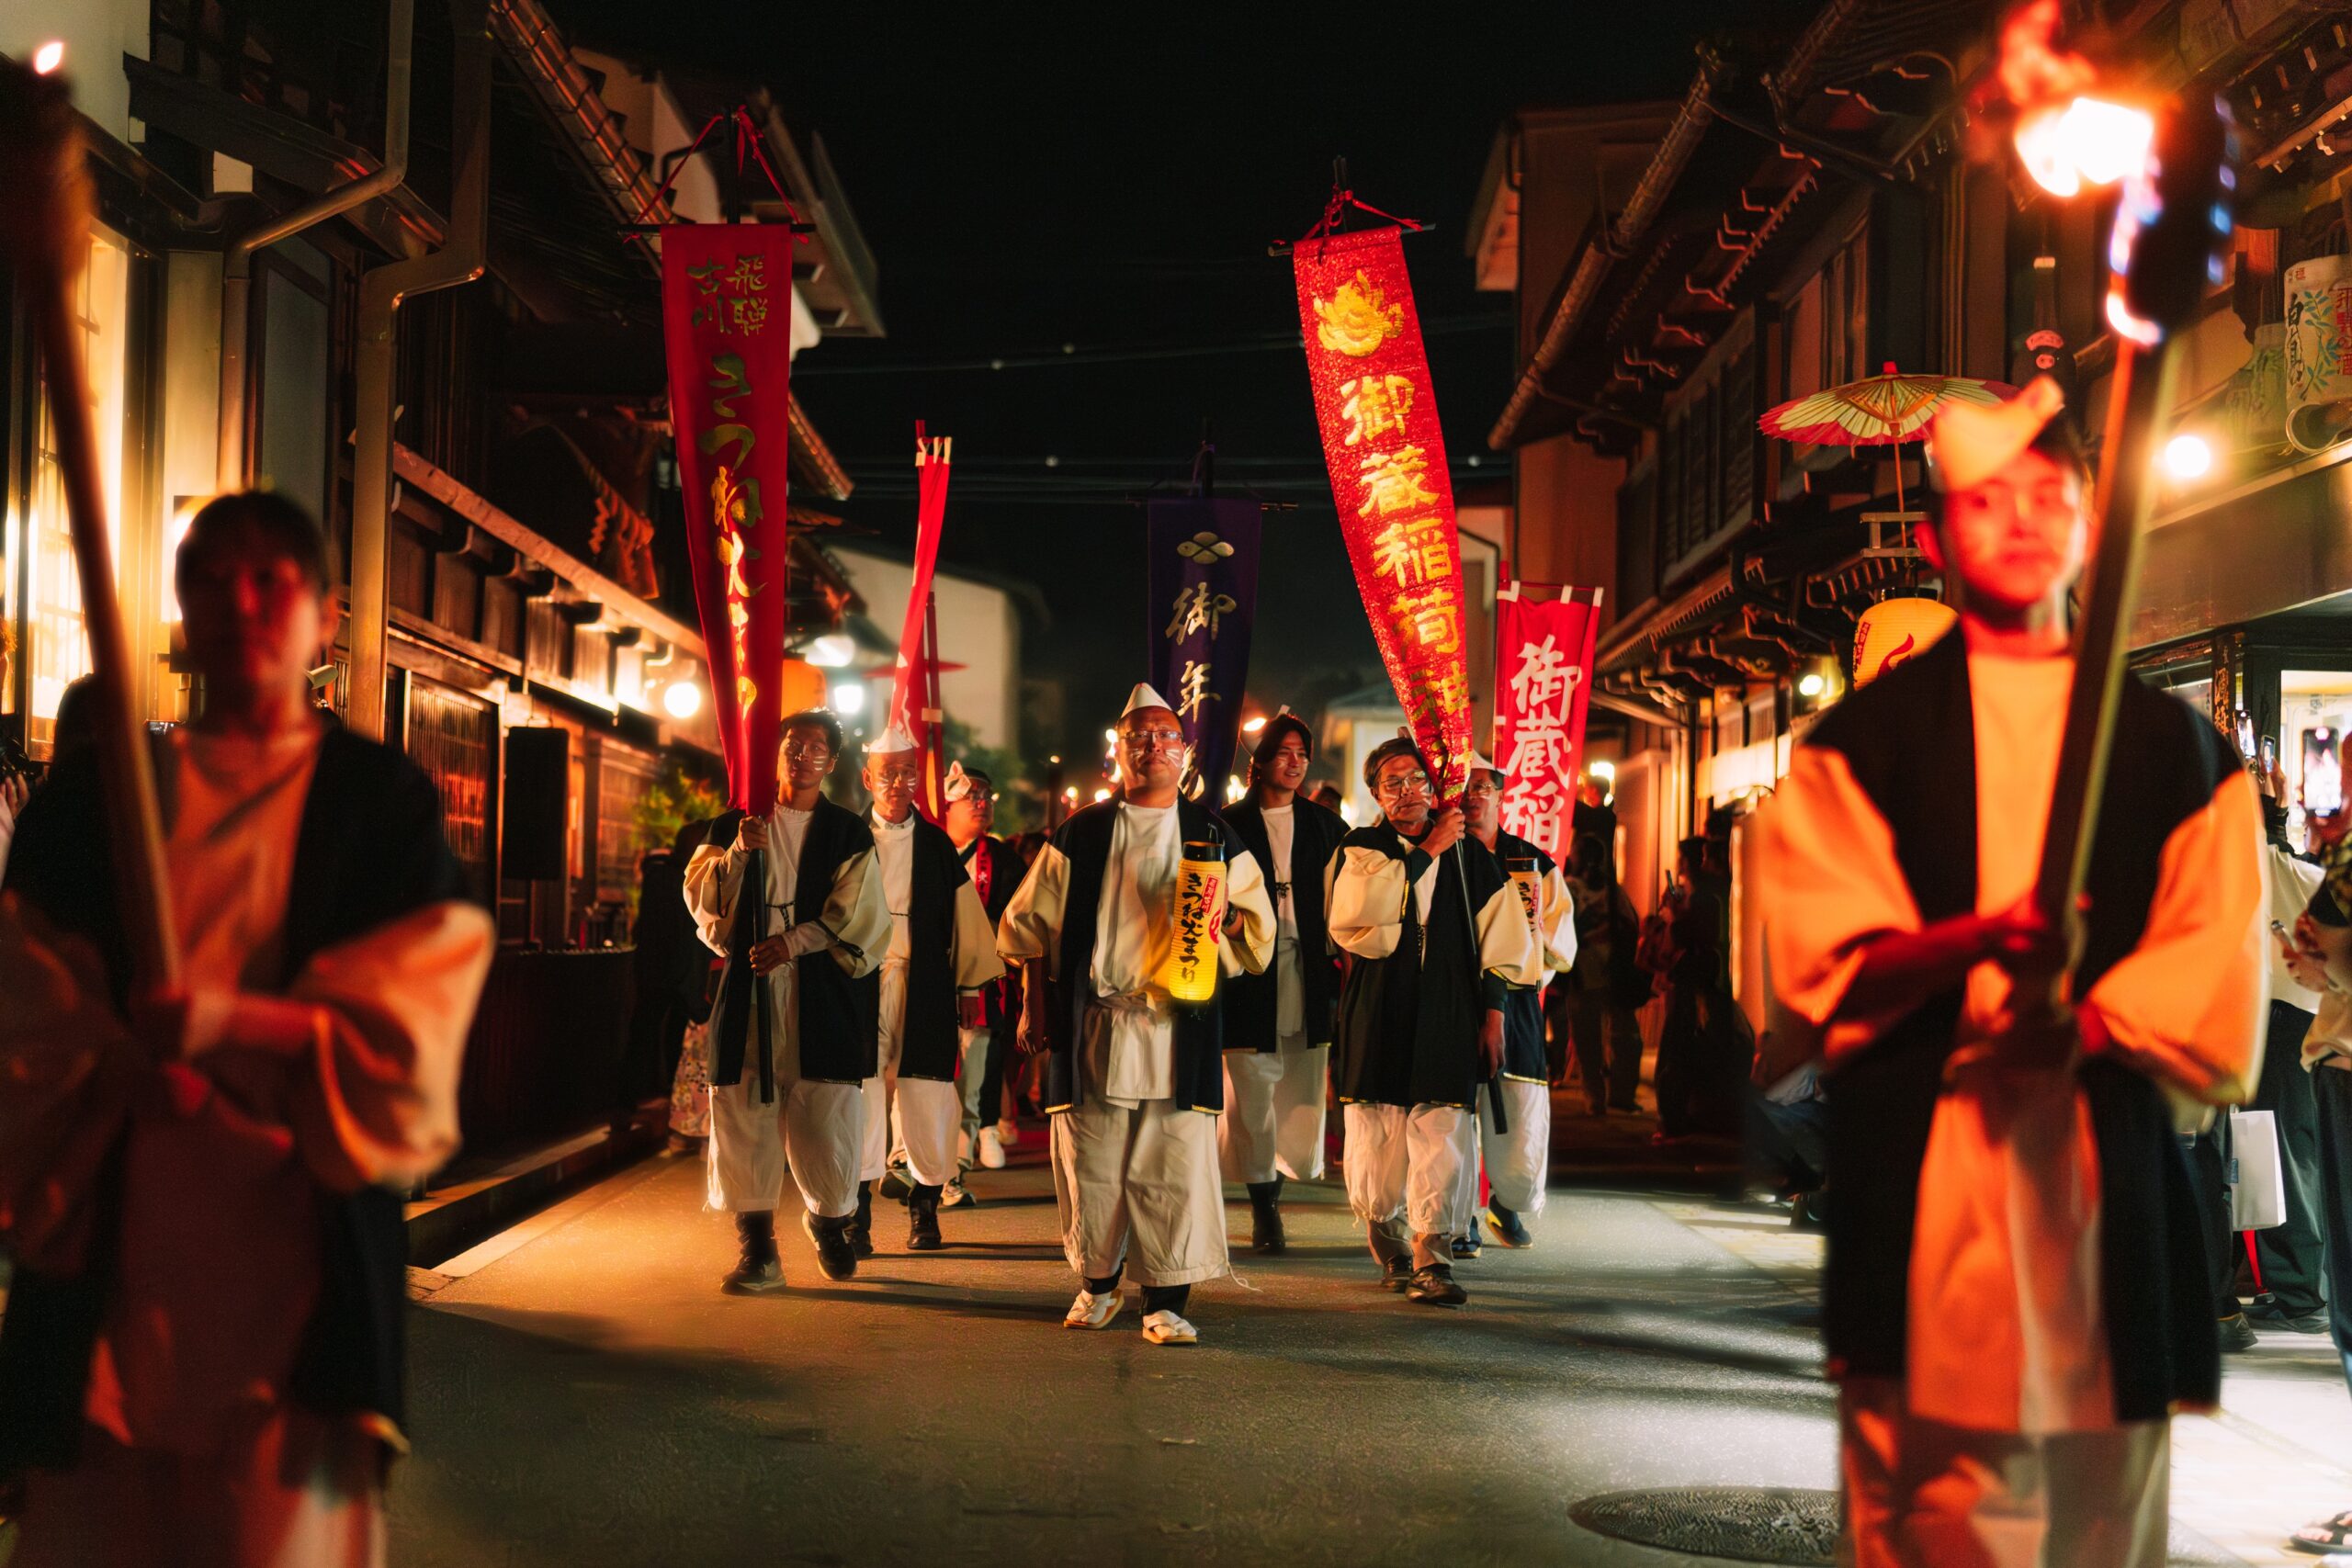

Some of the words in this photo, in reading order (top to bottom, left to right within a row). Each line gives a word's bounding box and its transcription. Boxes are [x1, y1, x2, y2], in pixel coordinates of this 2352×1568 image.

[1179, 872, 1204, 985] きつね火まつり
